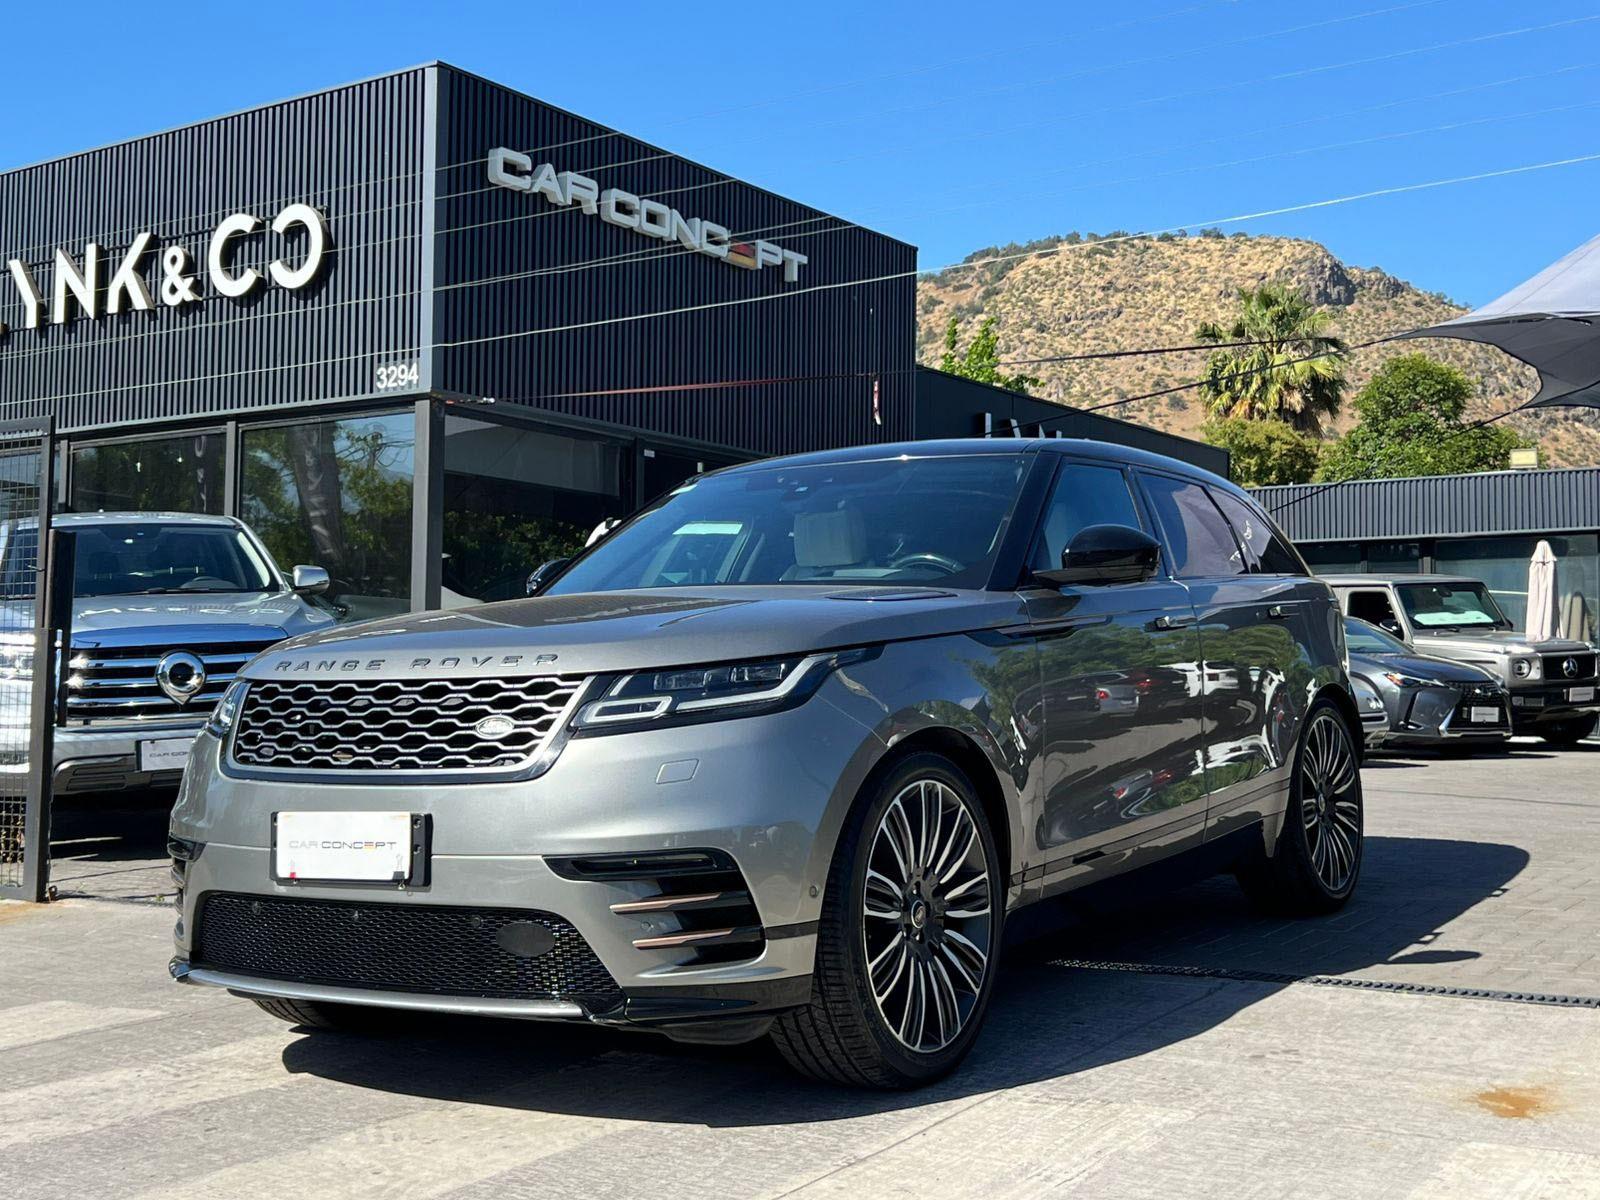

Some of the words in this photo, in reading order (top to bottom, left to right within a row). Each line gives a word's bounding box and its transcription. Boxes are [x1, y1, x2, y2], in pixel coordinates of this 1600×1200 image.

[487, 147, 599, 215] CAR
[600, 187, 808, 283] CONCEPT
[376, 362, 419, 389] 3294
[274, 659, 386, 672] RANGE
[408, 653, 559, 670] ROVER
[288, 840, 319, 850] CAR
[321, 841, 398, 850] CONCEPT
